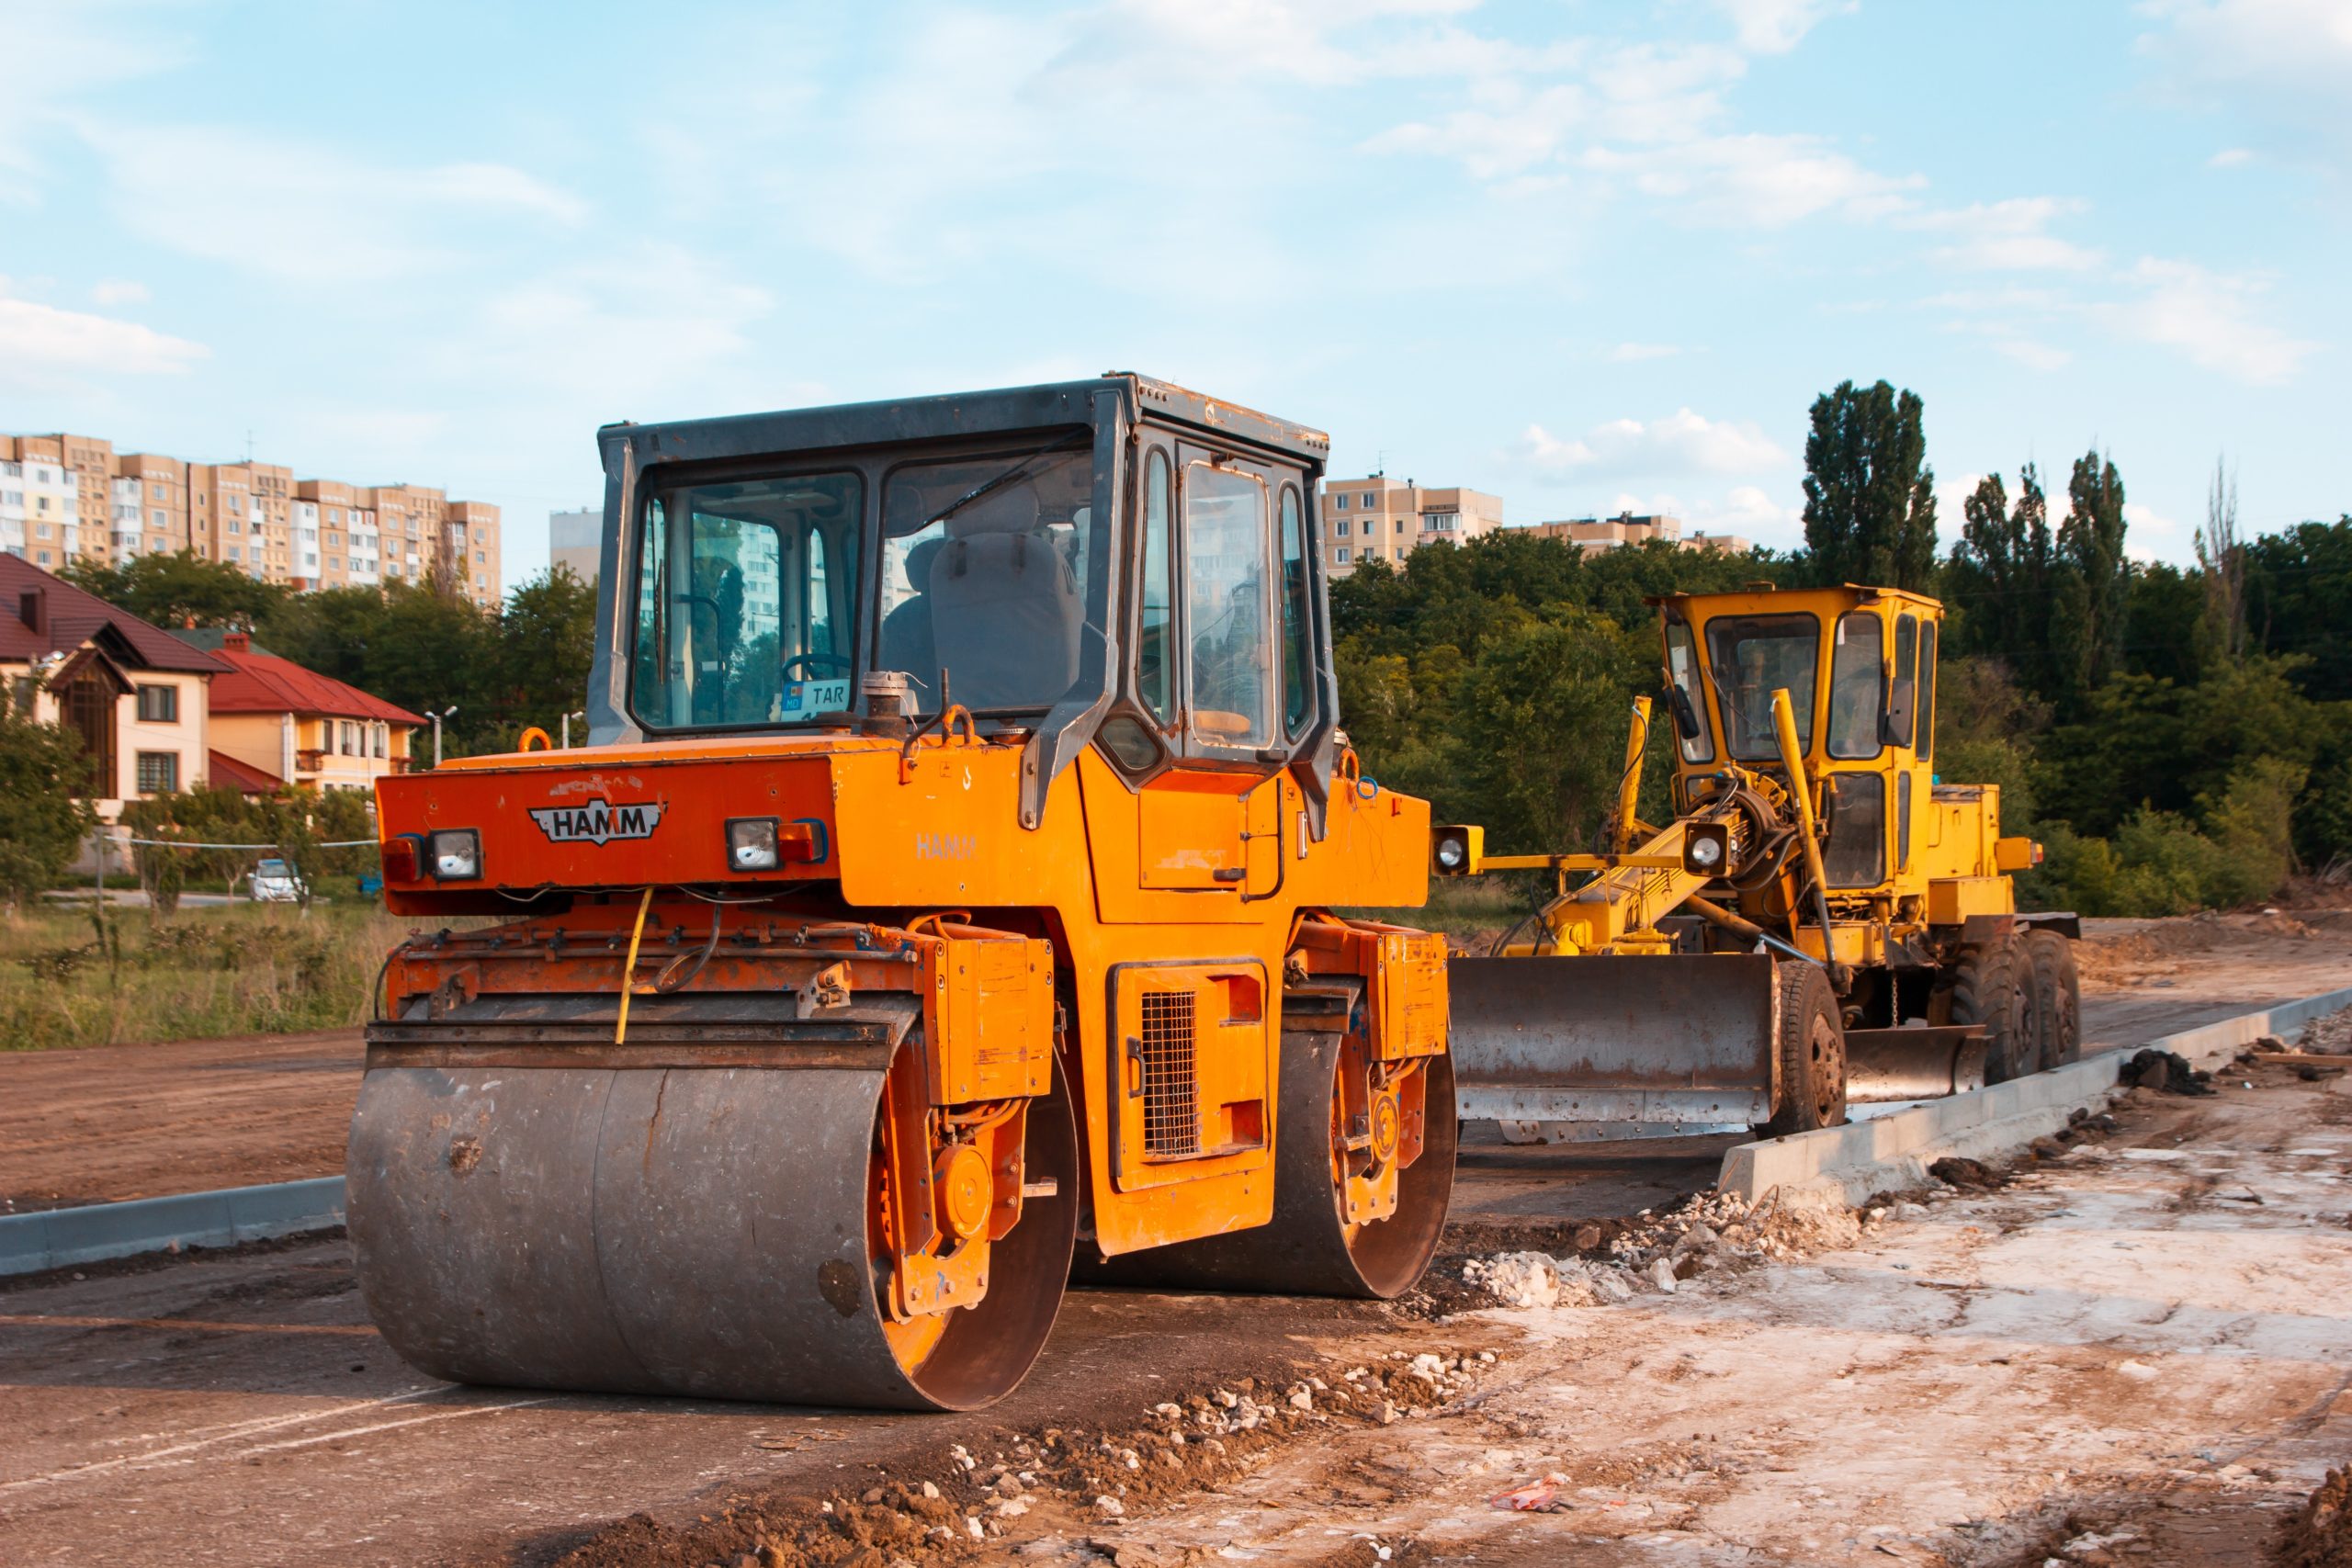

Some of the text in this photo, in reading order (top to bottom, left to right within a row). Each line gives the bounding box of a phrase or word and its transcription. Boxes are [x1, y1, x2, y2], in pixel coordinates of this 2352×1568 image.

[786, 699, 798, 708] MD
[813, 686, 843, 705] TAR
[553, 808, 647, 837] HAMM
